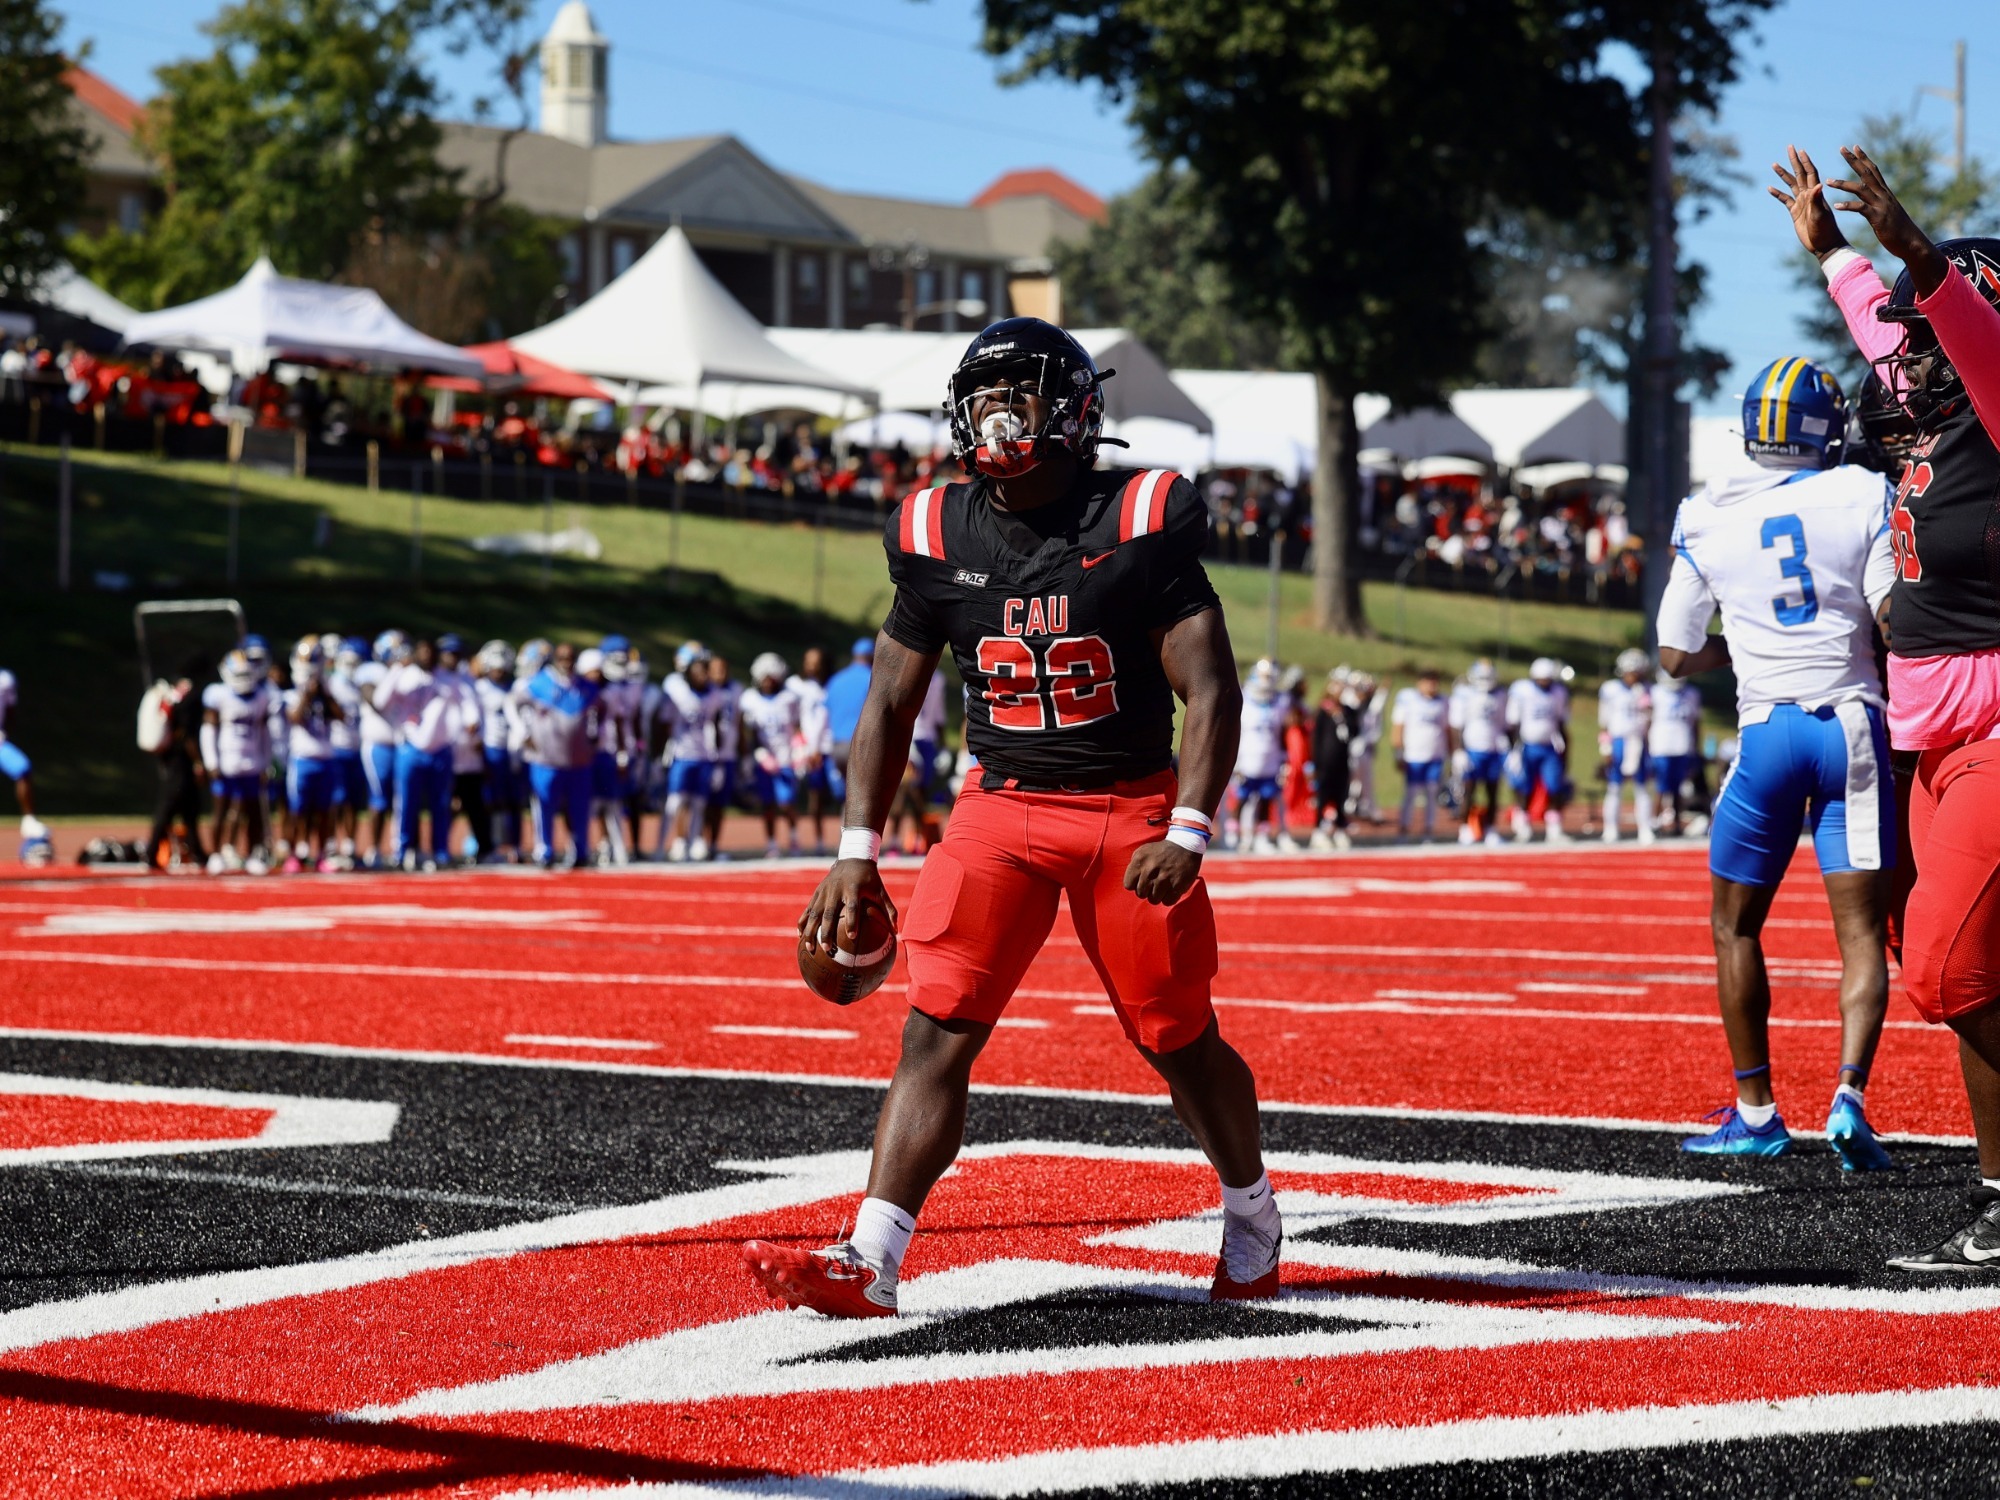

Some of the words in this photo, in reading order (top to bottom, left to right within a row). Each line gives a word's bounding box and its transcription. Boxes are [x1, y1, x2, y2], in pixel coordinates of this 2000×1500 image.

[1748, 441, 1800, 456] Riddell
[956, 571, 987, 584] SIAC
[1760, 513, 1819, 628] 3
[1004, 595, 1069, 637] CAU
[976, 635, 1120, 731] 22
